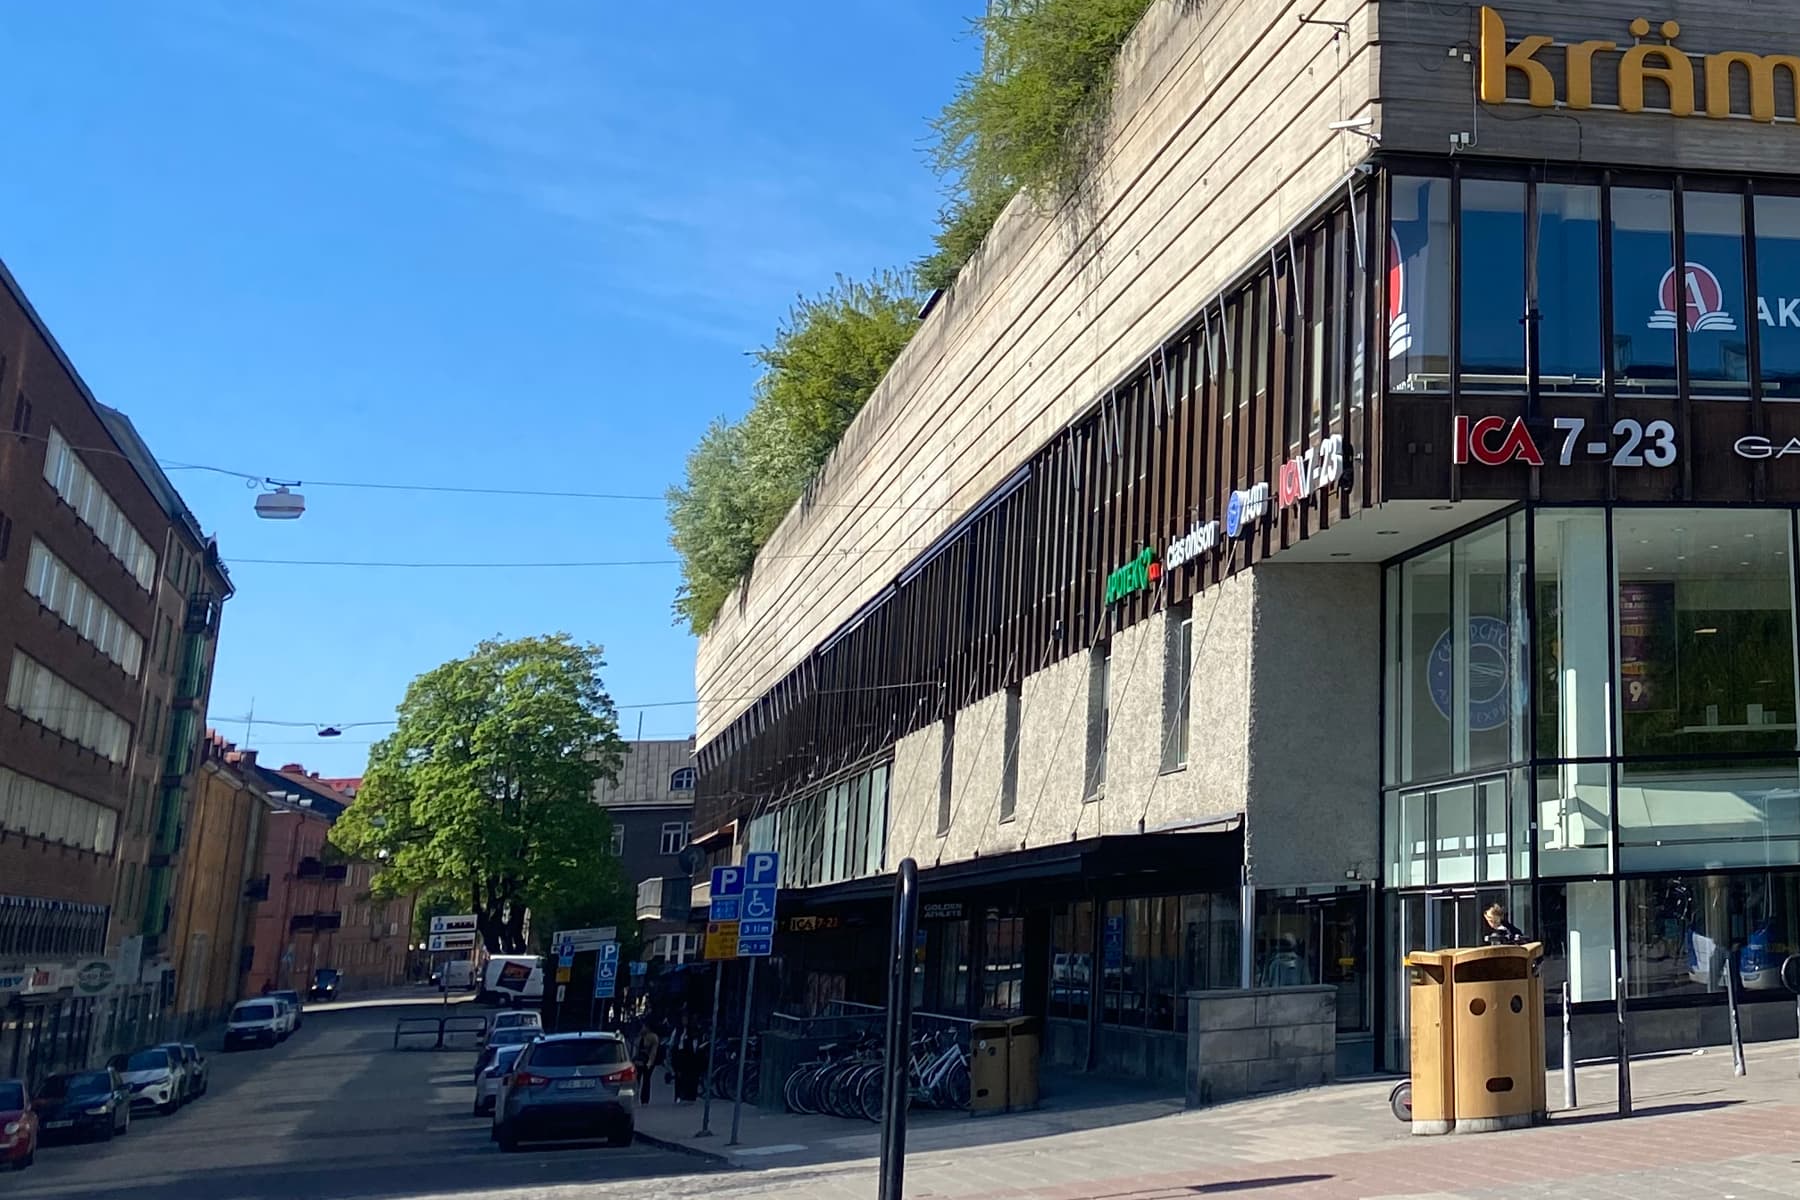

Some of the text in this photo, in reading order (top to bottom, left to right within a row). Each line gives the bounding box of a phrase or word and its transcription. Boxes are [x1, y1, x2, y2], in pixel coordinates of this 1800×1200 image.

[1454, 415, 1677, 468] ICA 7-23
[1167, 520, 1215, 571] clas ohlson
[720, 869, 738, 894] P
[753, 855, 773, 882] P
[605, 944, 616, 960] P
